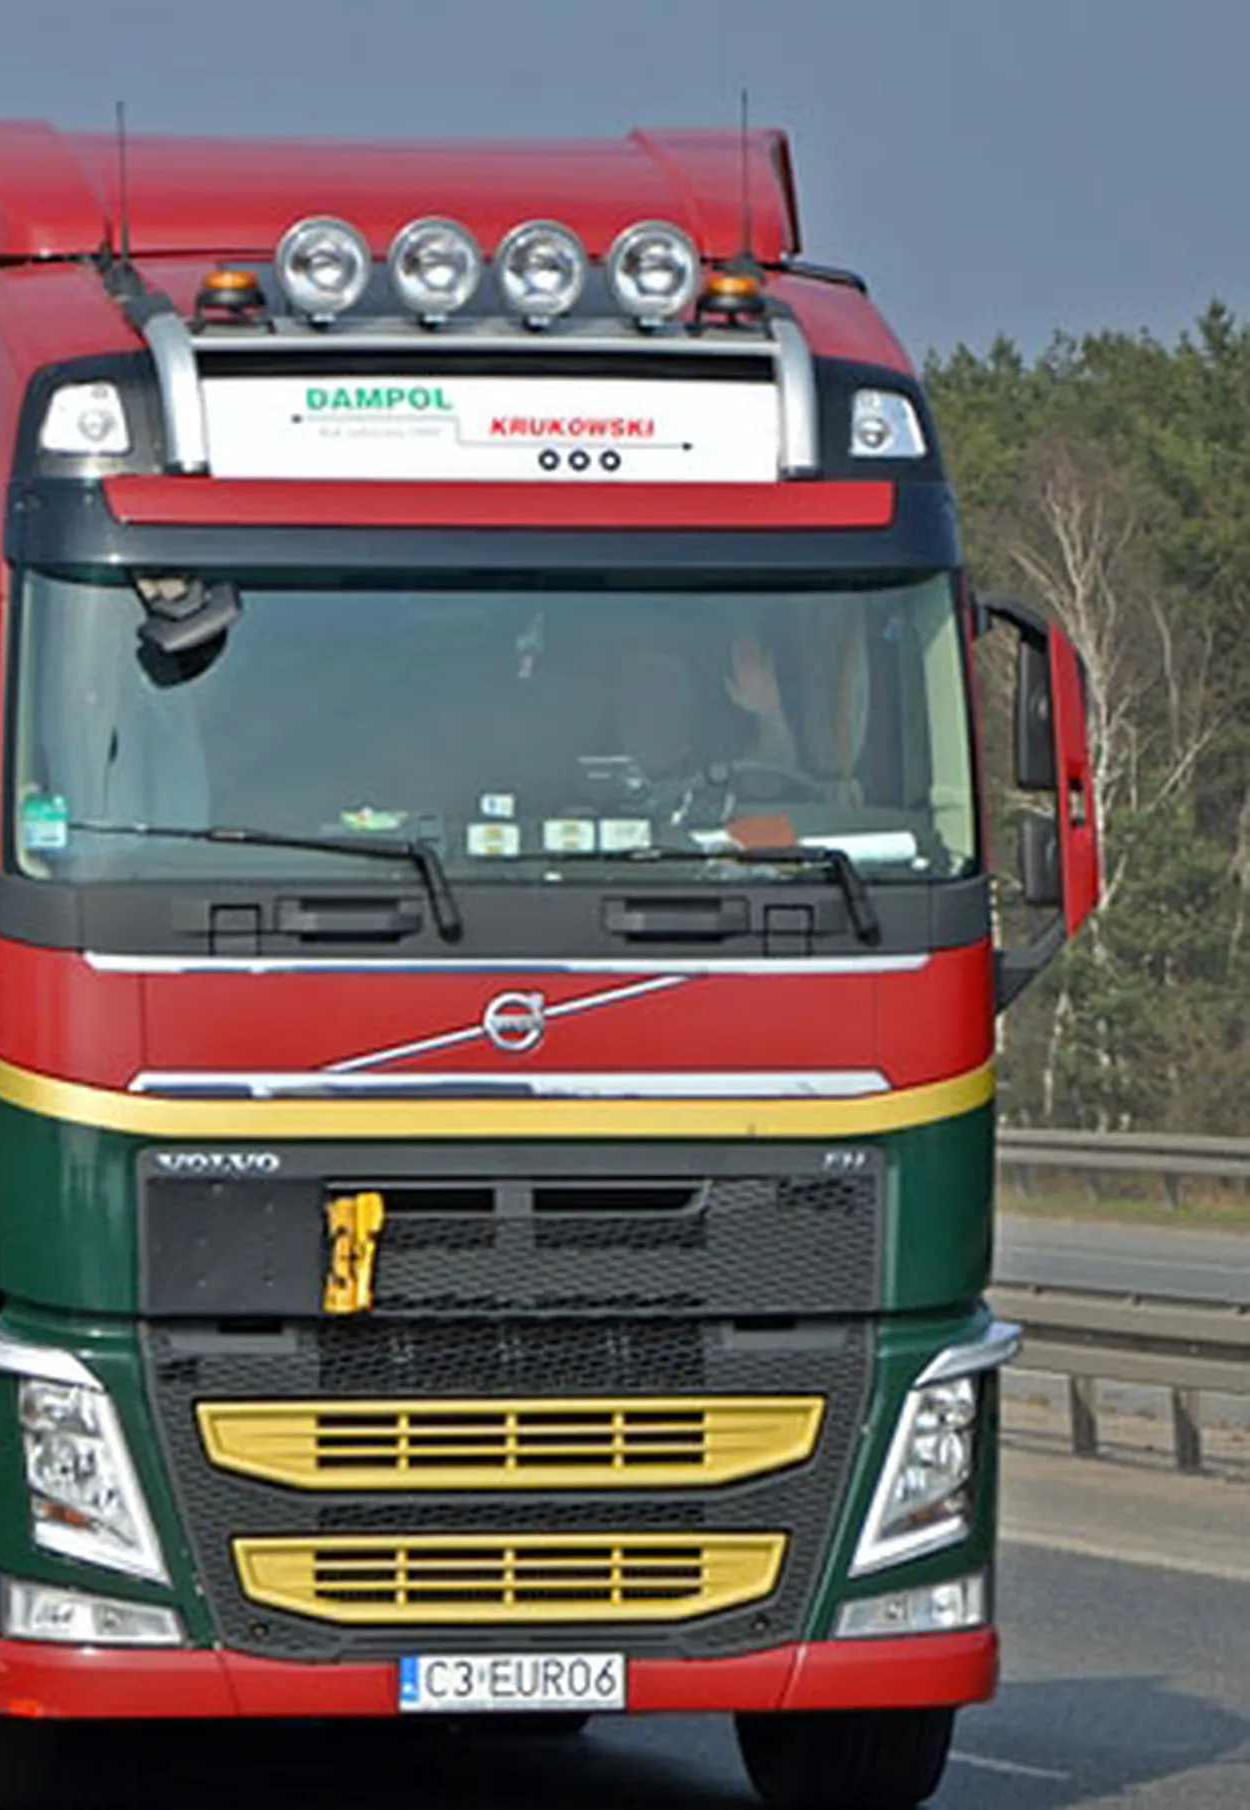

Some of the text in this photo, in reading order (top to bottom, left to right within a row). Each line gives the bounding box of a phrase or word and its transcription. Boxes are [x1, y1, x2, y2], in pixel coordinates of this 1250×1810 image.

[306, 387, 454, 410] DAMPOL
[490, 417, 656, 437] KRUKOWSKI
[156, 1152, 280, 1174] VOLVO
[425, 1660, 474, 1698] C3
